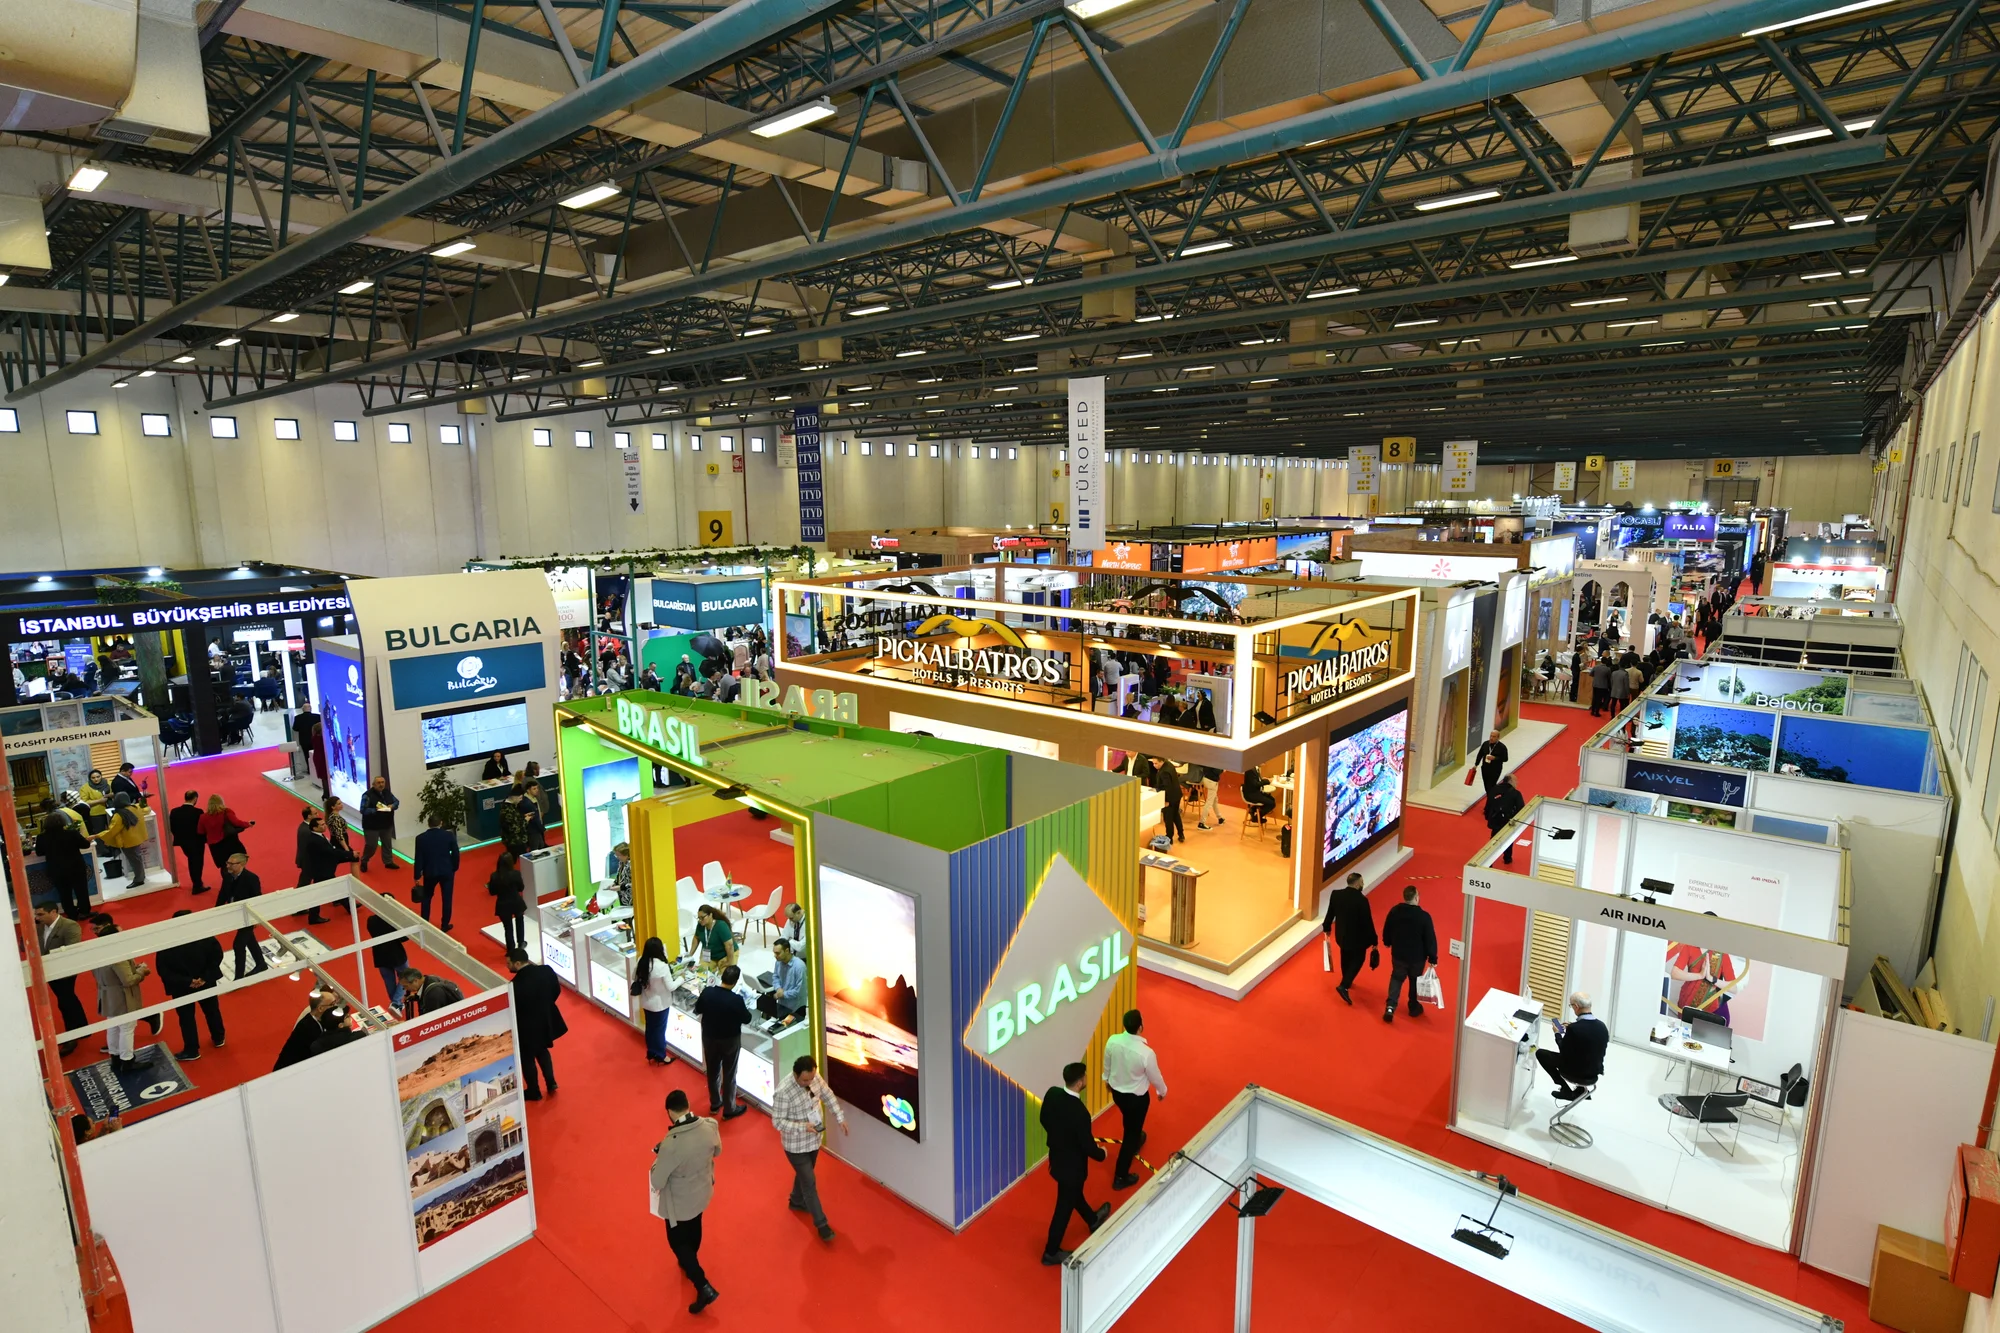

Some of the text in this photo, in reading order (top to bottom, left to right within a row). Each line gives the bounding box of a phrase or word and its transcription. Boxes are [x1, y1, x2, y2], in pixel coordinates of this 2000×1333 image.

[796, 416, 818, 427] TTYD
[797, 434, 818, 446] TTYD
[1076, 401, 1089, 506] TÜROFED
[1389, 442, 1400, 457] 8
[798, 452, 819, 464] TTYD
[1590, 459, 1597, 468] 8
[709, 465, 714, 473] 9
[1716, 463, 1731, 473] 10
[799, 470, 820, 482] TTYD
[800, 489, 822, 501] TTYD
[801, 507, 822, 518] TTYD
[1052, 508, 1059, 524] 9
[1264, 502, 1270, 515] 9
[709, 519, 723, 543] 9
[801, 525, 824, 537] TTYD
[1672, 523, 1706, 531] ITALIA
[653, 598, 696, 614] BULGARİSTAN
[701, 596, 758, 612] BULGARIA
[19, 596, 350, 635] İSTANBUL BÜYÜKŞEHİR BELEDİYESİ
[385, 616, 542, 651] BULGARIA
[876, 636, 1060, 684] PICKALBATROS
[1286, 642, 1389, 696] PICKALBATROS
[912, 667, 1025, 695] HOTELS & RESORTS
[1310, 687, 1336, 705] HOTELS
[1344, 672, 1372, 693] RESORTS
[1755, 694, 1825, 714] Belavia
[13, 738, 47, 749] GASHT
[49, 733, 87, 744] PARSEH
[89, 729, 111, 738] IRAN
[616, 697, 706, 766] BRASIL
[1469, 879, 1491, 889] 8510
[1688, 879, 1713, 889] EXPERIENCE
[1761, 877, 1777, 885] INDIA
[1687, 885, 1731, 898] INDIAN HOSPITALITY
[1600, 906, 1667, 930] AIR INDIA
[986, 930, 1130, 1055] BRASIL
[419, 1005, 487, 1036] AZADI IRAN TOURS
